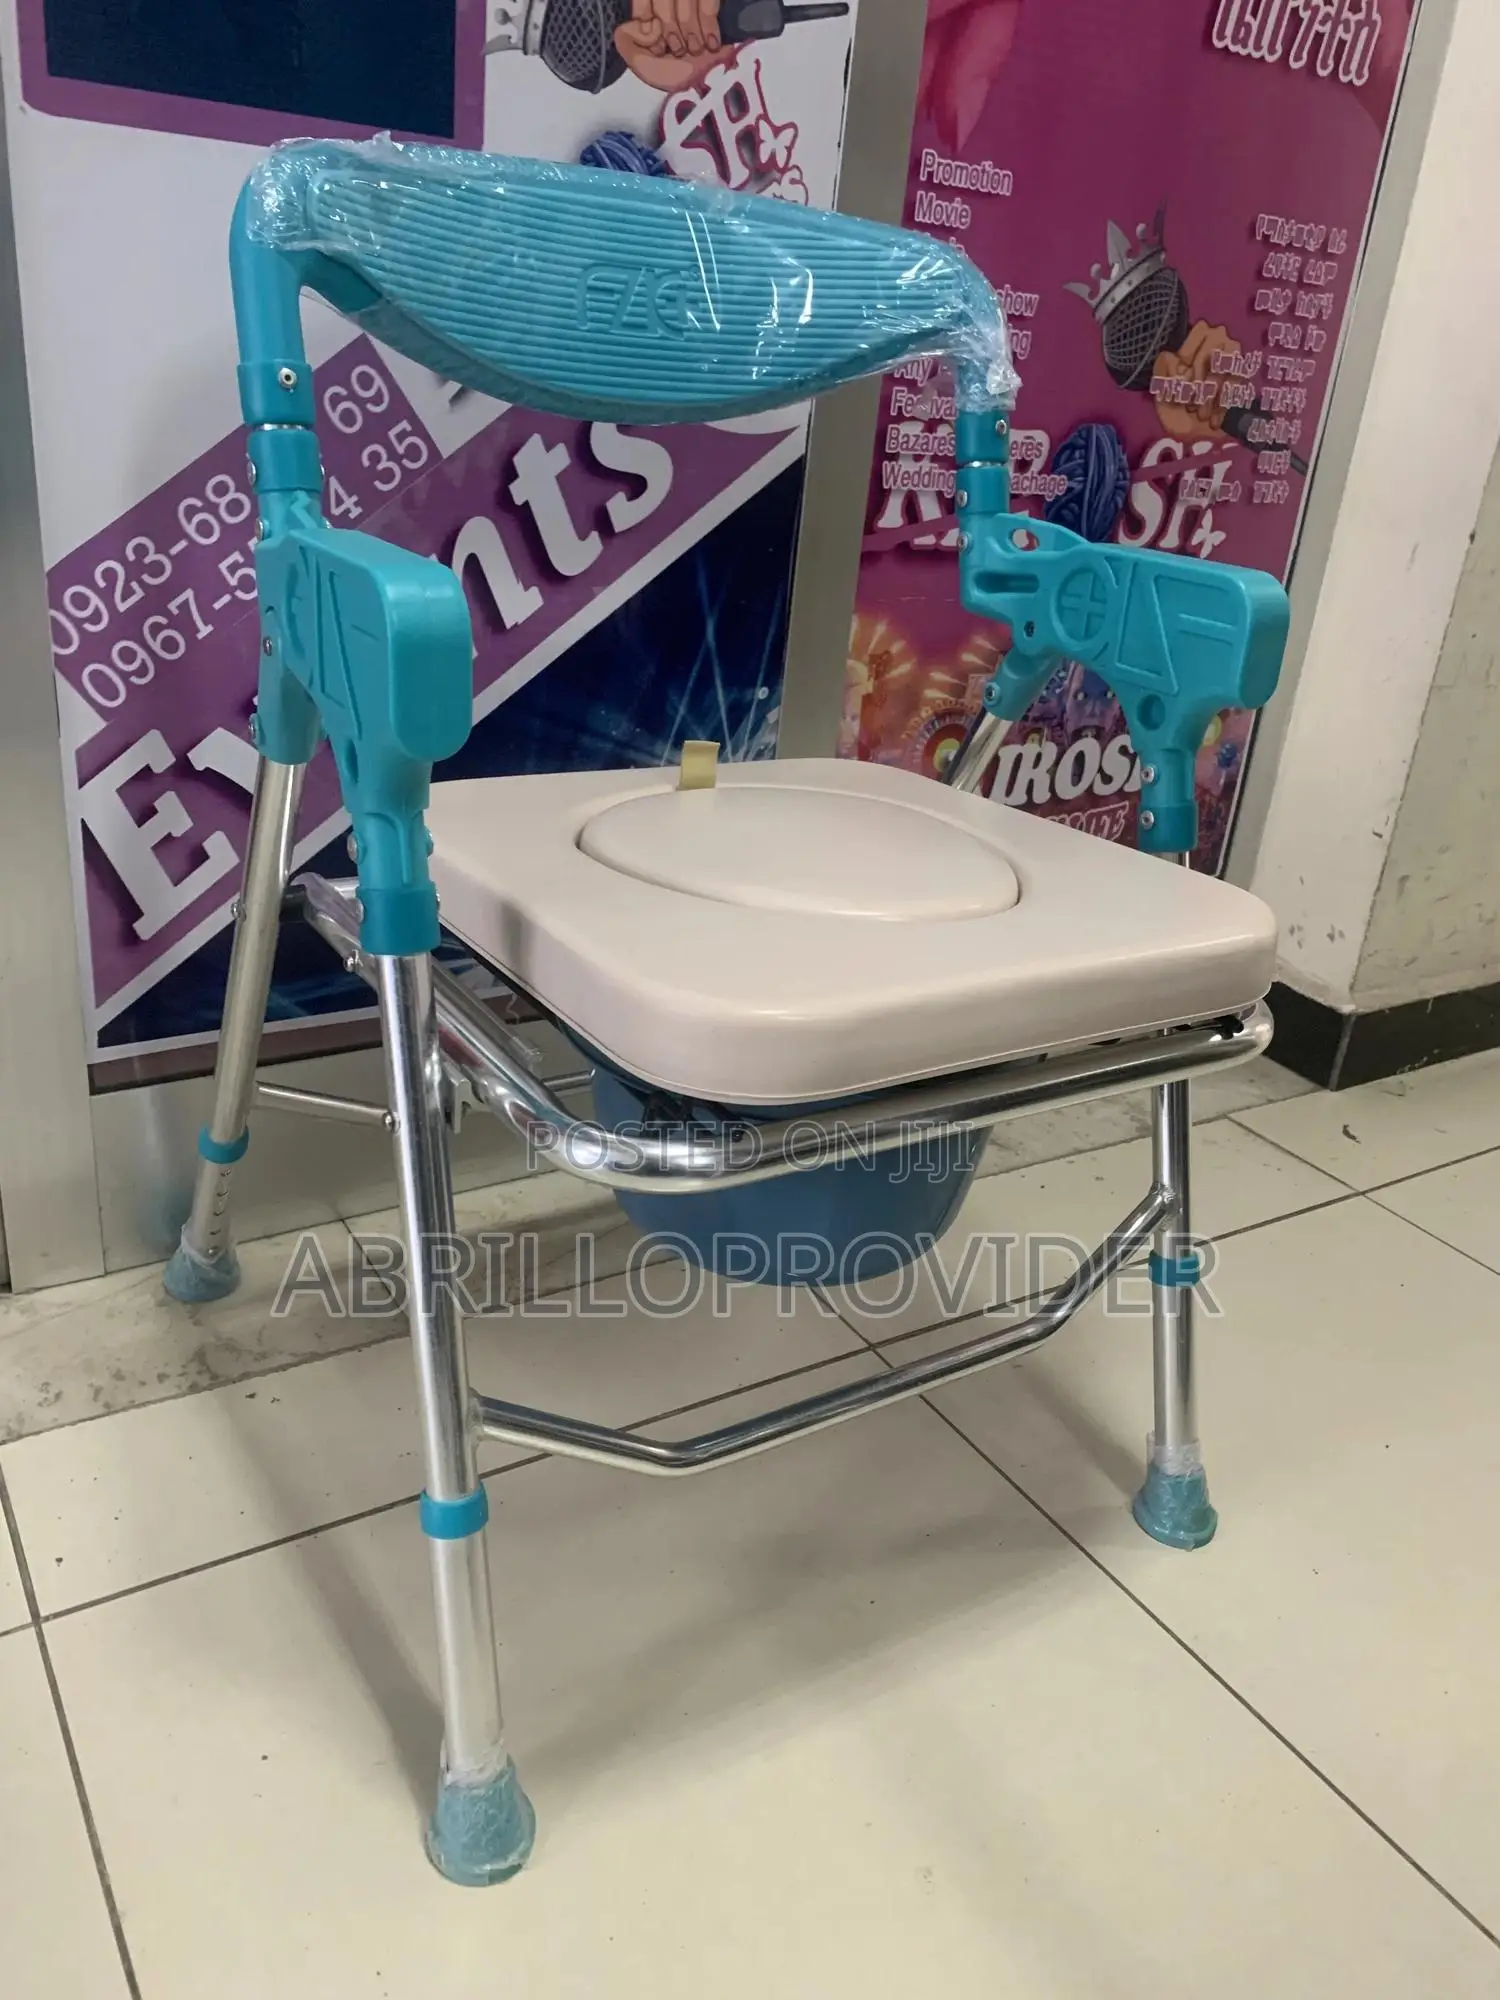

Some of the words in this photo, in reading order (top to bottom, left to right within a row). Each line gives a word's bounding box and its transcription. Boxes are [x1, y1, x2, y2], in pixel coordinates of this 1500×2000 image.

[920, 149, 1013, 196] Promotion
[915, 191, 971, 229] Movie
[323, 364, 390, 434] 69
[882, 460, 957, 499] Wedding
[1009, 472, 1070, 502] achage
[81, 537, 258, 708] 0967-5
[361, 420, 429, 491] 35
